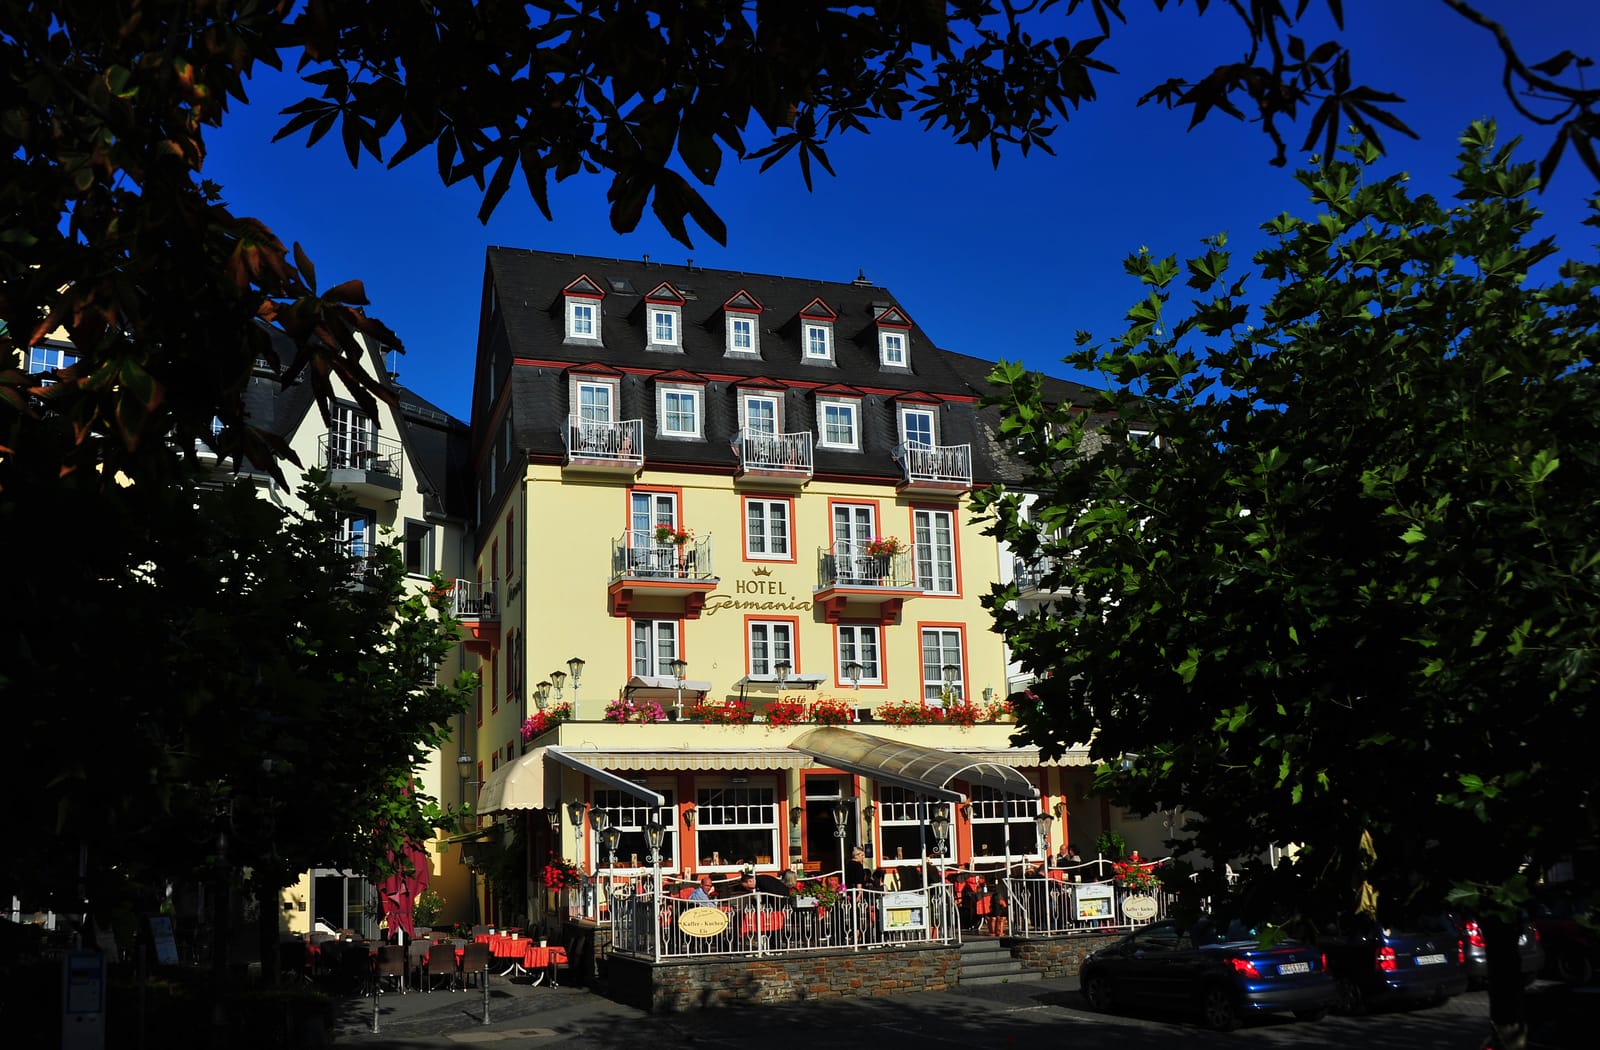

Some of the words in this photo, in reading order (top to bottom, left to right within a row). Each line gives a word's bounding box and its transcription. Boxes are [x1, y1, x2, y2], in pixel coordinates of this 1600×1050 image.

[736, 580, 787, 595] HOTEL
[702, 594, 813, 616] Germania
[784, 695, 806, 704] Café
